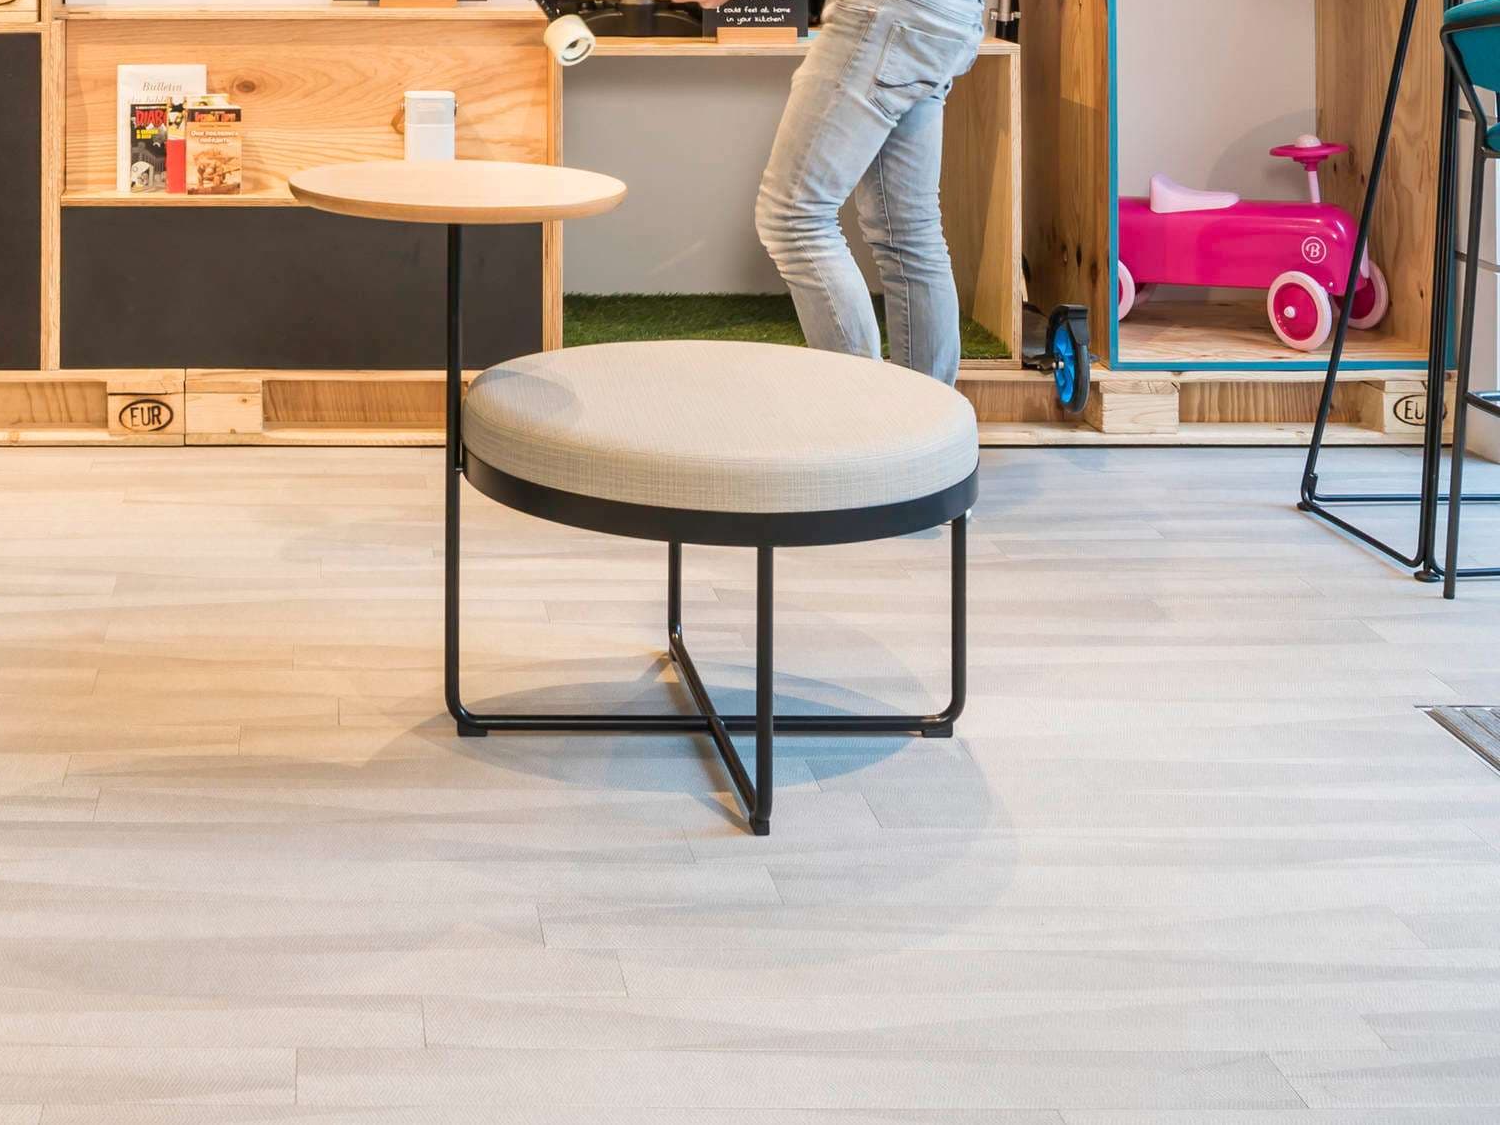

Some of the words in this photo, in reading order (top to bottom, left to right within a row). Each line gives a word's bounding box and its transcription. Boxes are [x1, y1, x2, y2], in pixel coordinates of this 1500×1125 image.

[744, 5, 758, 13] feel
[737, 17, 751, 25] your
[142, 81, 182, 92] Bulletin
[1305, 242, 1322, 259] B
[130, 405, 162, 427] EUR
[1404, 399, 1427, 421] EU
